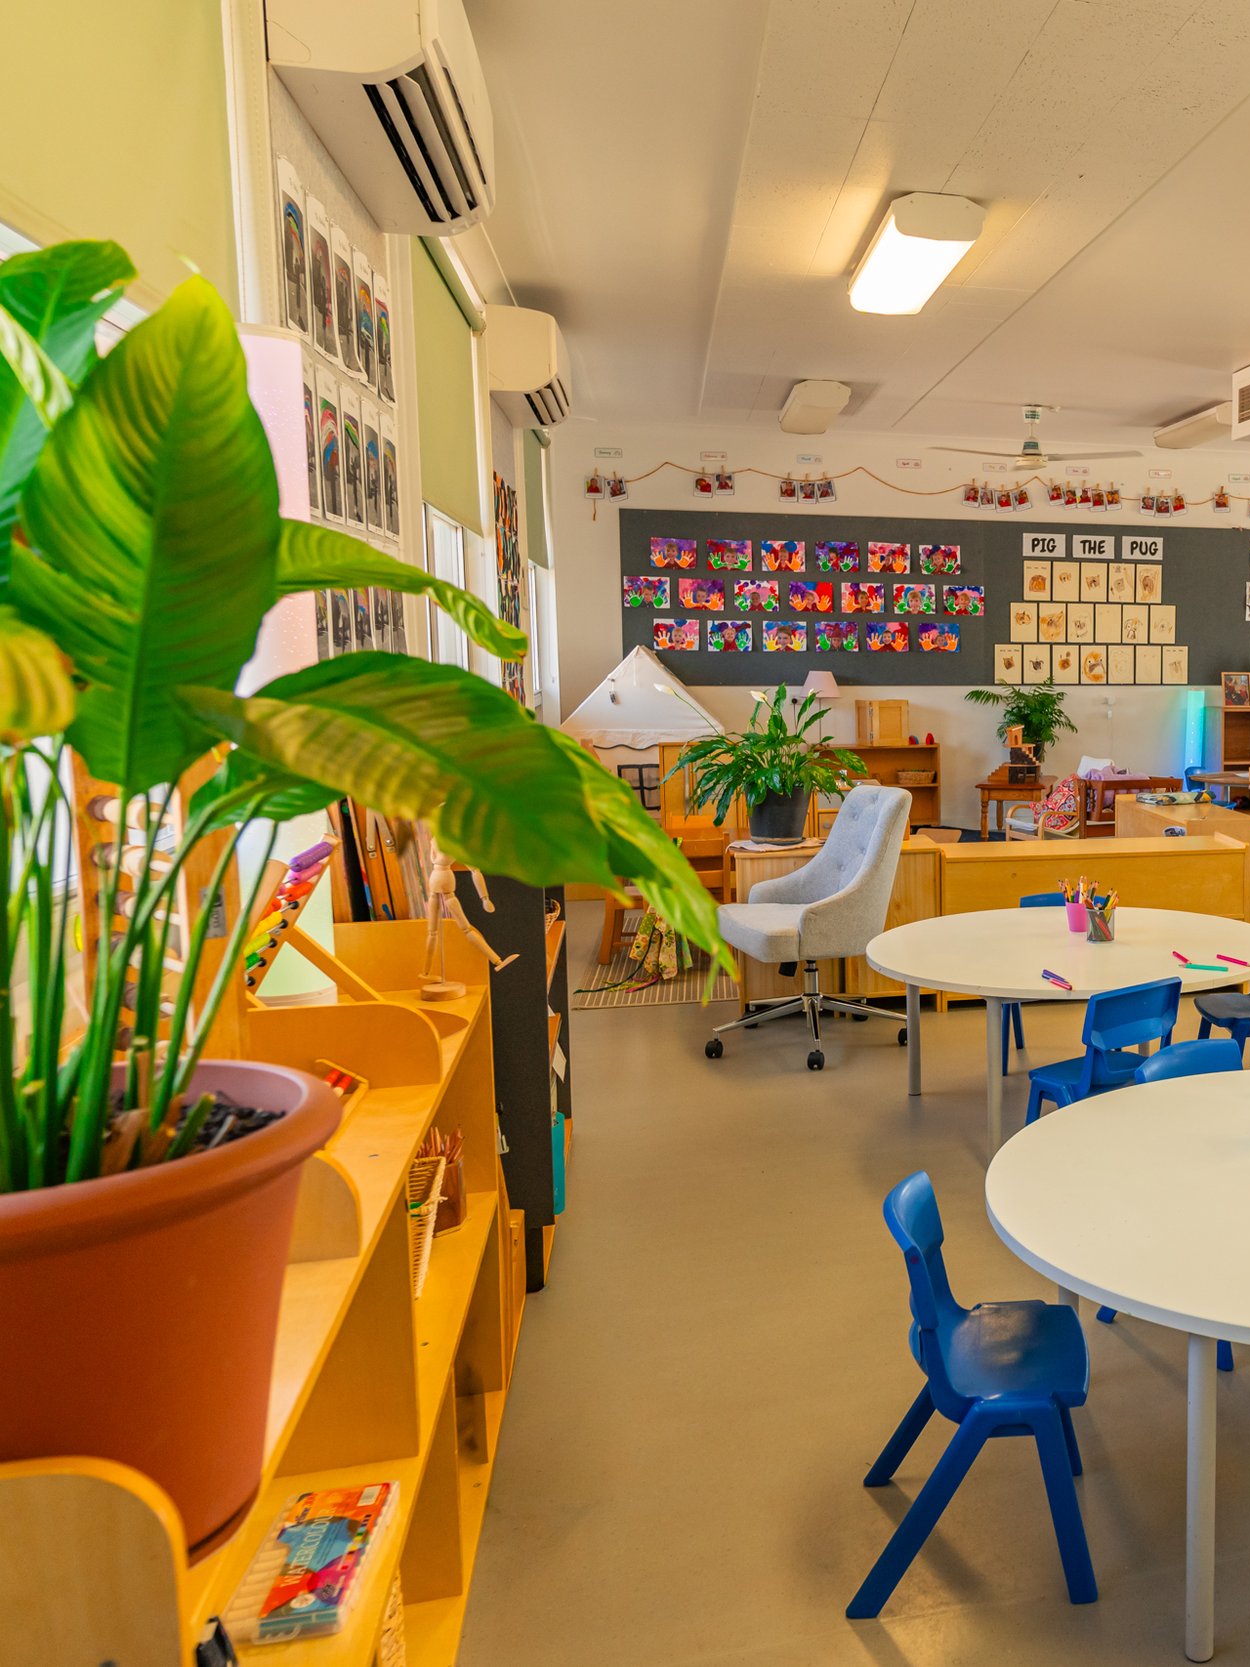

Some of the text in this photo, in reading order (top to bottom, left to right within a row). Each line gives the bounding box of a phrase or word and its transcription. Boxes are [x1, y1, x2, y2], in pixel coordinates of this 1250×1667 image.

[1031, 538, 1158, 556] PIG THE PUG
